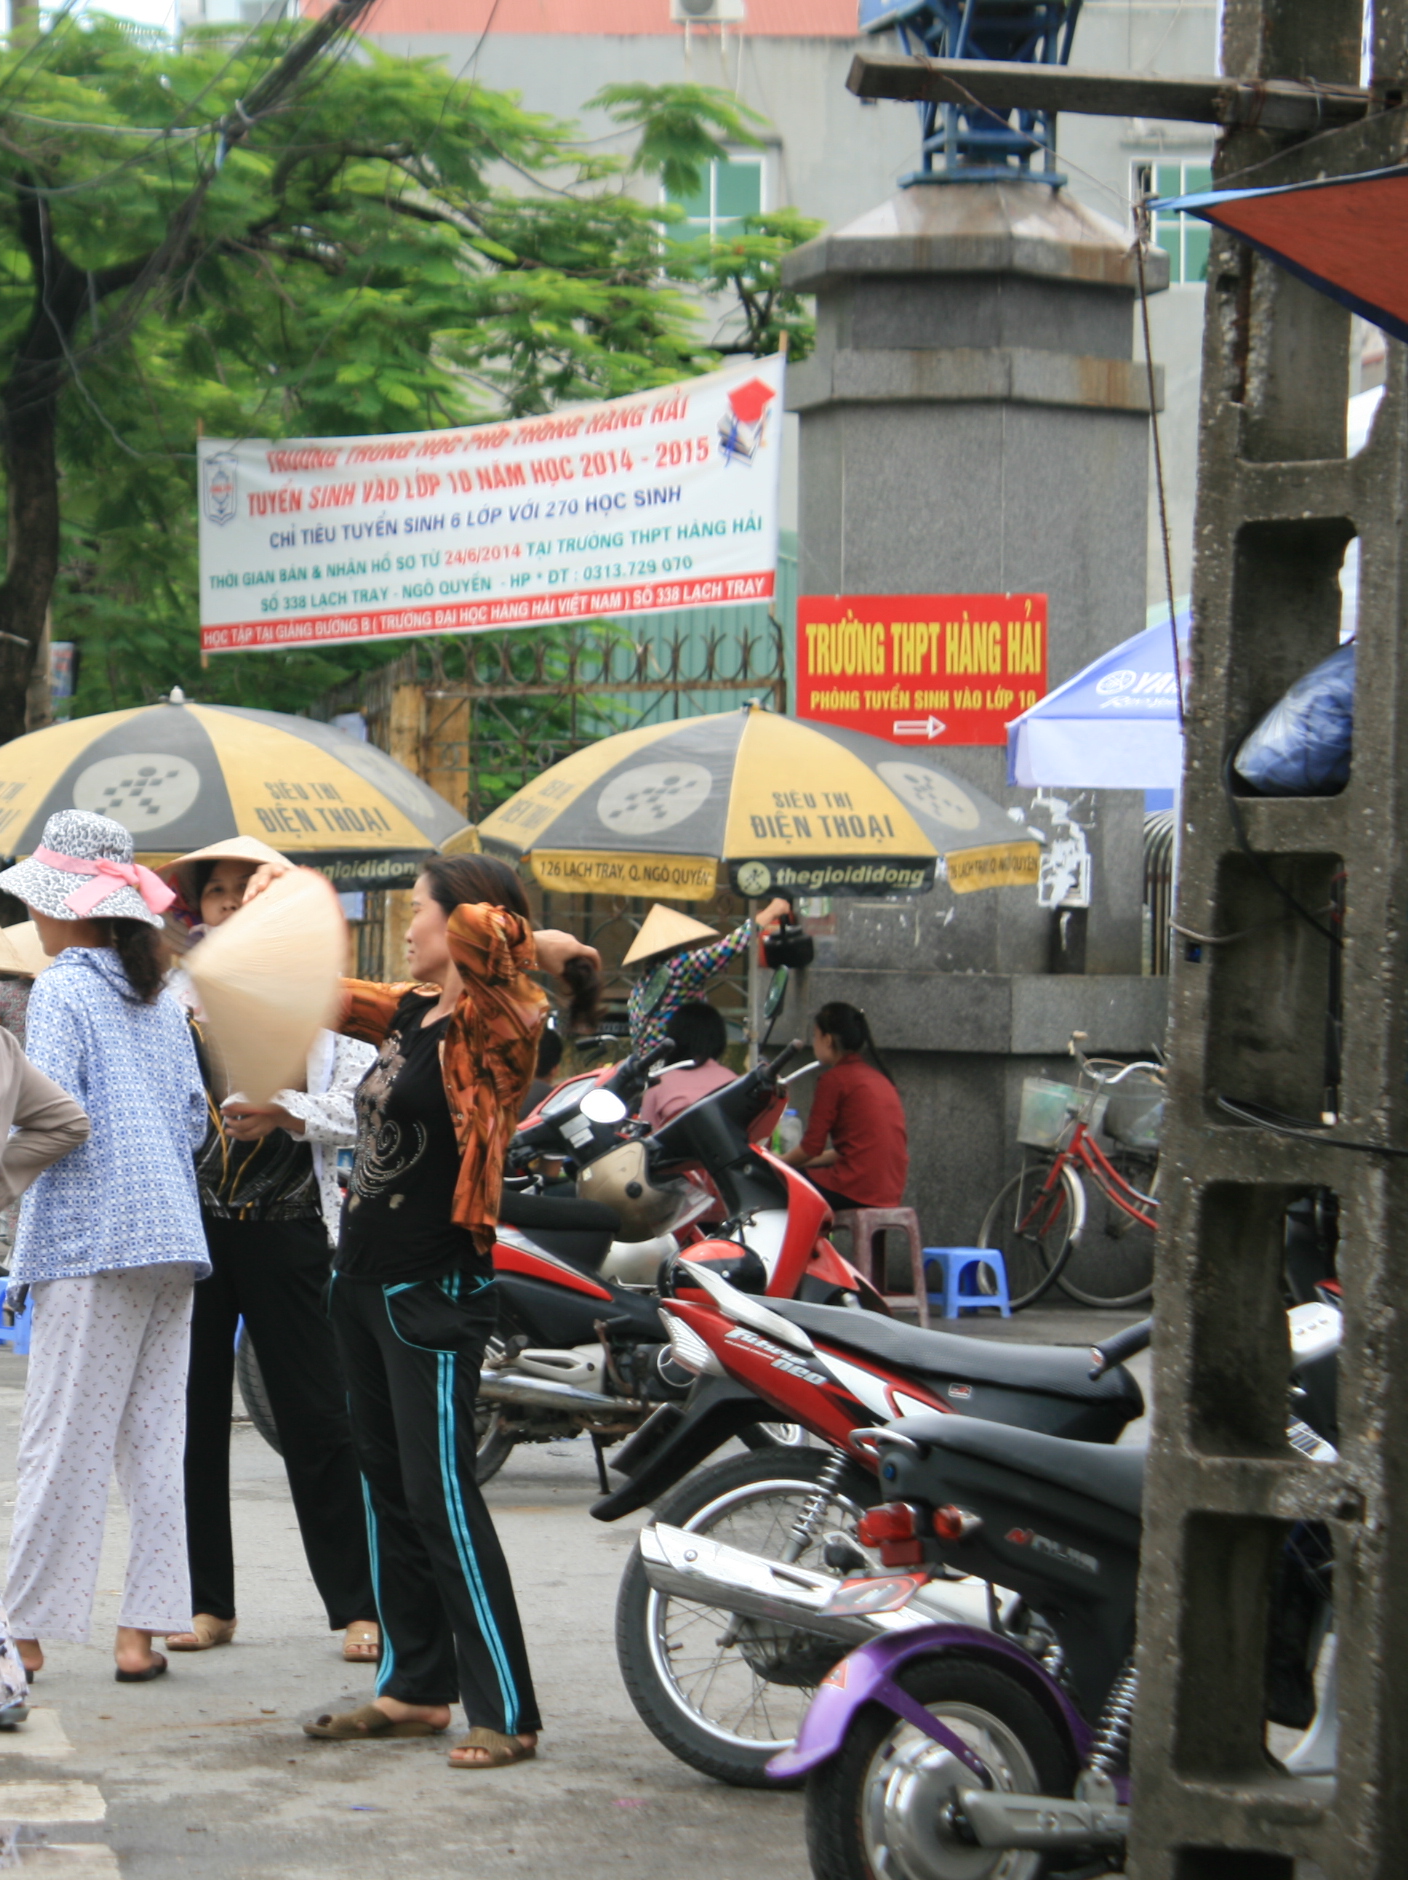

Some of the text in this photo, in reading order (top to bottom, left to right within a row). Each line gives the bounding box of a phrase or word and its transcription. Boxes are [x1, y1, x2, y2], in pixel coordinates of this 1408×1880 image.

[585, 403, 648, 435] HÀNG
[650, 386, 690, 424] HẢI
[309, 481, 356, 510] SINH
[362, 473, 400, 504] VÀO
[405, 466, 441, 499] LỚP
[447, 468, 473, 495] 10
[476, 457, 526, 491] NĂM
[530, 454, 575, 489] HỌC
[580, 446, 634, 478] 2014
[655, 435, 710, 468] 2015
[269, 485, 682, 549] CHỈ TIÊU TUYỂN SINH 6 LỚP VỚI 270 HỌC SINH
[242, 570, 275, 587] GIAN
[311, 564, 321, 579] &
[326, 556, 367, 580] NHẬN
[444, 543, 522, 567] 24/6/2014
[525, 540, 552, 563] TẠI
[629, 526, 672, 546] THPT
[677, 518, 726, 540] HÀNG
[732, 509, 762, 534] HẢI
[261, 590, 279, 612] SỐ
[283, 595, 306, 610] 338
[311, 591, 347, 611] LẠCH
[352, 586, 389, 604] TRAY
[402, 578, 434, 599] NGÔ
[510, 572, 531, 588] HP
[583, 557, 657, 581] 0313.729
[661, 555, 693, 573] 070
[360, 616, 370, 631] B
[434, 608, 457, 629] ĐẠI
[459, 605, 488, 625] HỌC
[490, 598, 529, 619] HÀNG
[531, 593, 554, 617] HẢI
[558, 592, 588, 616] VIỆT
[590, 590, 622, 612] NAM
[633, 582, 654, 608] SỐ
[656, 584, 680, 606] 338
[682, 580, 723, 604] LẠCH
[726, 576, 766, 596] TRAY
[805, 598, 1043, 676] TRƯỜNG THPT HÀNG HẢI
[809, 682, 1037, 711] PHÒNG TUYỂN SINH VÀO LỚP 10
[264, 778, 345, 804] SIÊU THỊ
[772, 788, 854, 812] SIÊU THỊ
[254, 802, 393, 839] ĐIỆN THOẠI
[750, 811, 895, 844] ĐIỆN THOẠI
[540, 860, 561, 877] 126
[643, 862, 670, 882] NGÔ
[776, 863, 926, 890] thegioididong
[724, 1324, 808, 1366] Future
[770, 1358, 828, 1386] neo
